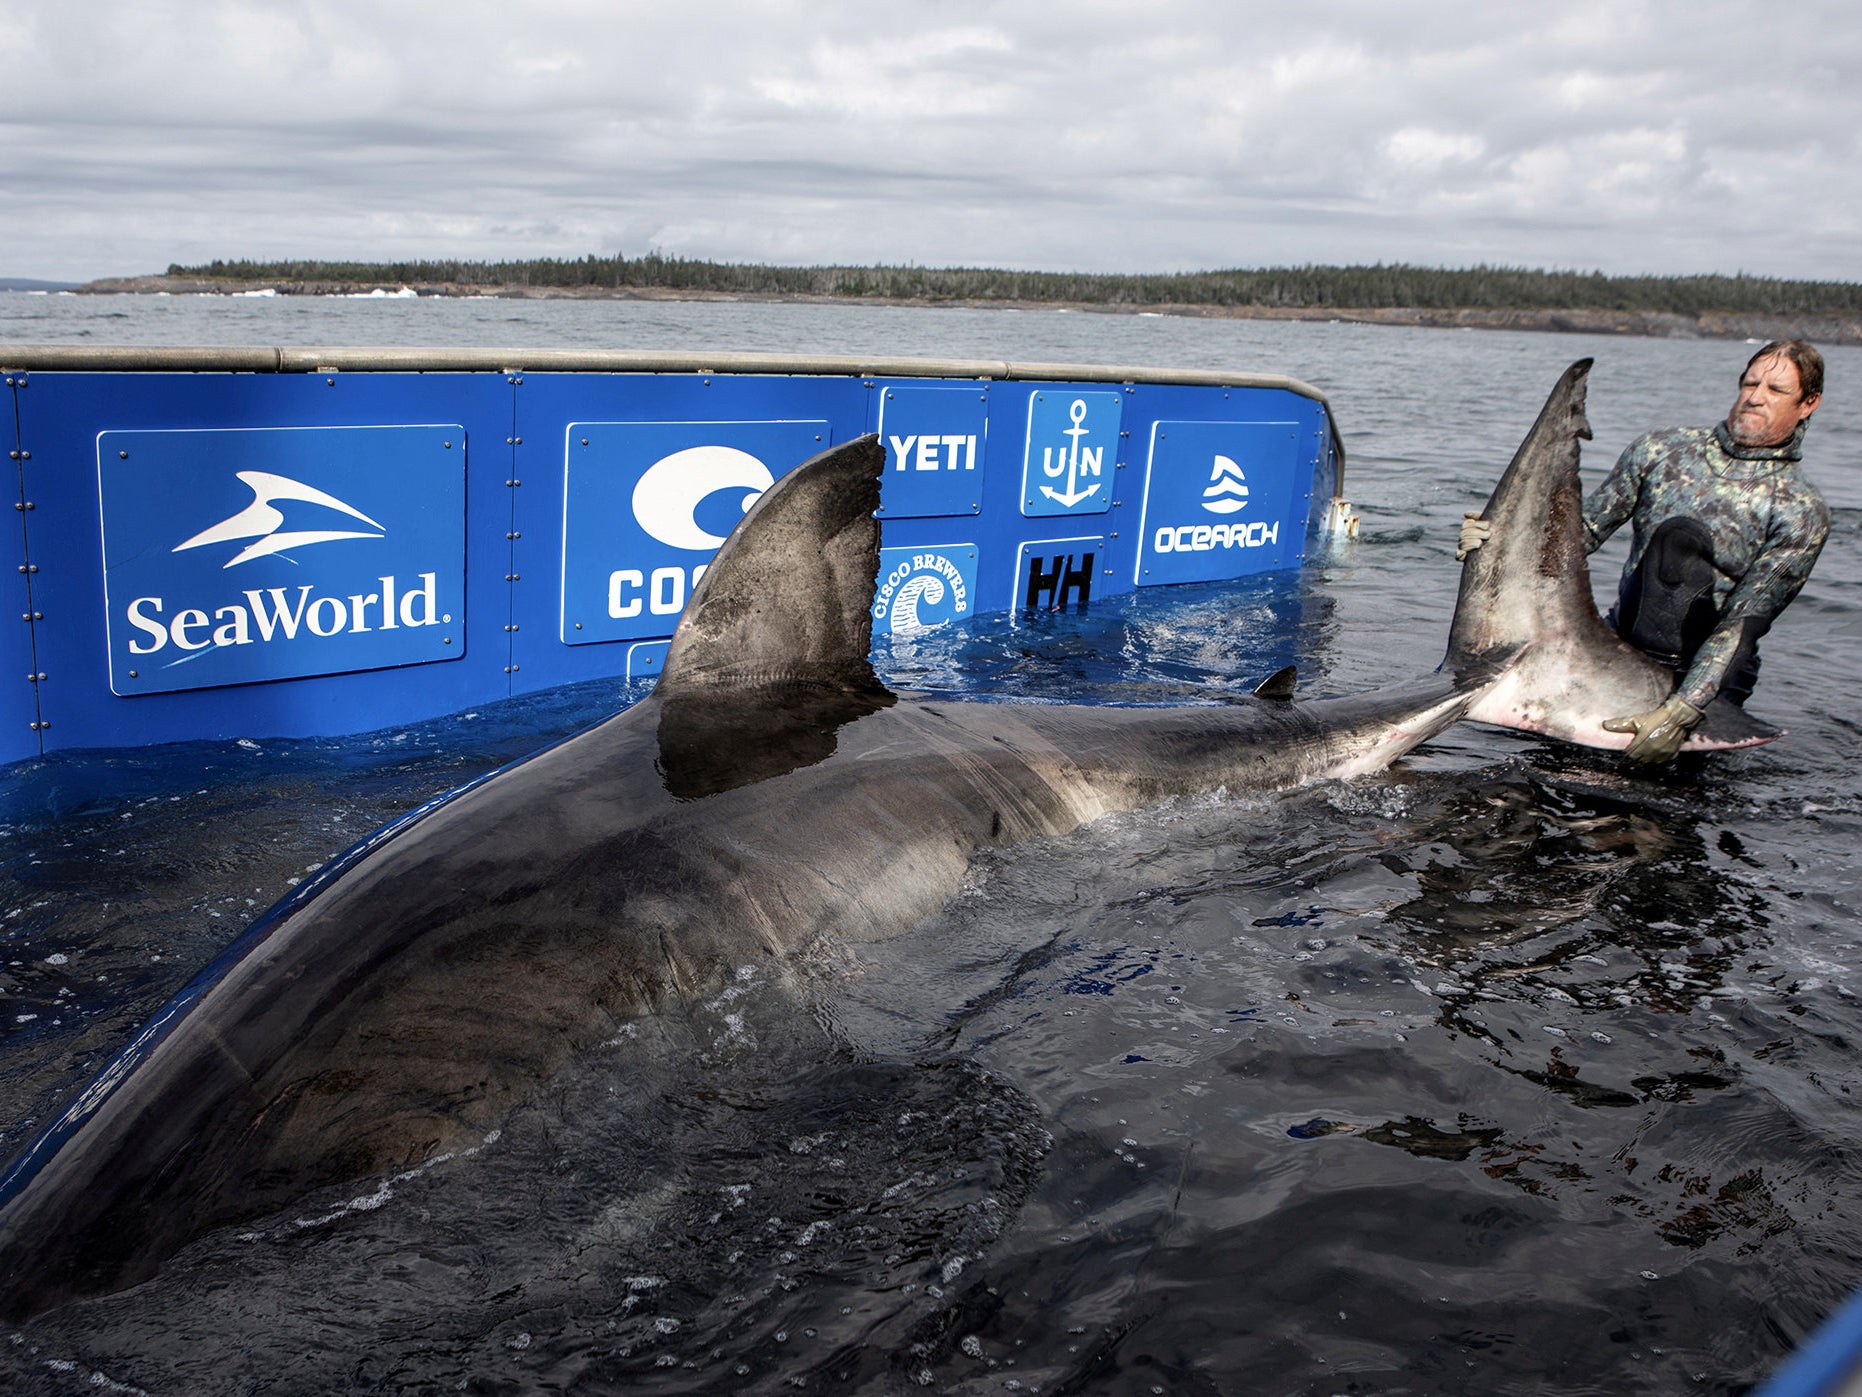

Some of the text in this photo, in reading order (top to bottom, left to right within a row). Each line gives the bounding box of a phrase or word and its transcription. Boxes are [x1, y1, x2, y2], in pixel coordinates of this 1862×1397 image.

[889, 434, 976, 471] YETI
[608, 564, 709, 619] CO
[874, 553, 967, 619] CISCO BREWERS
